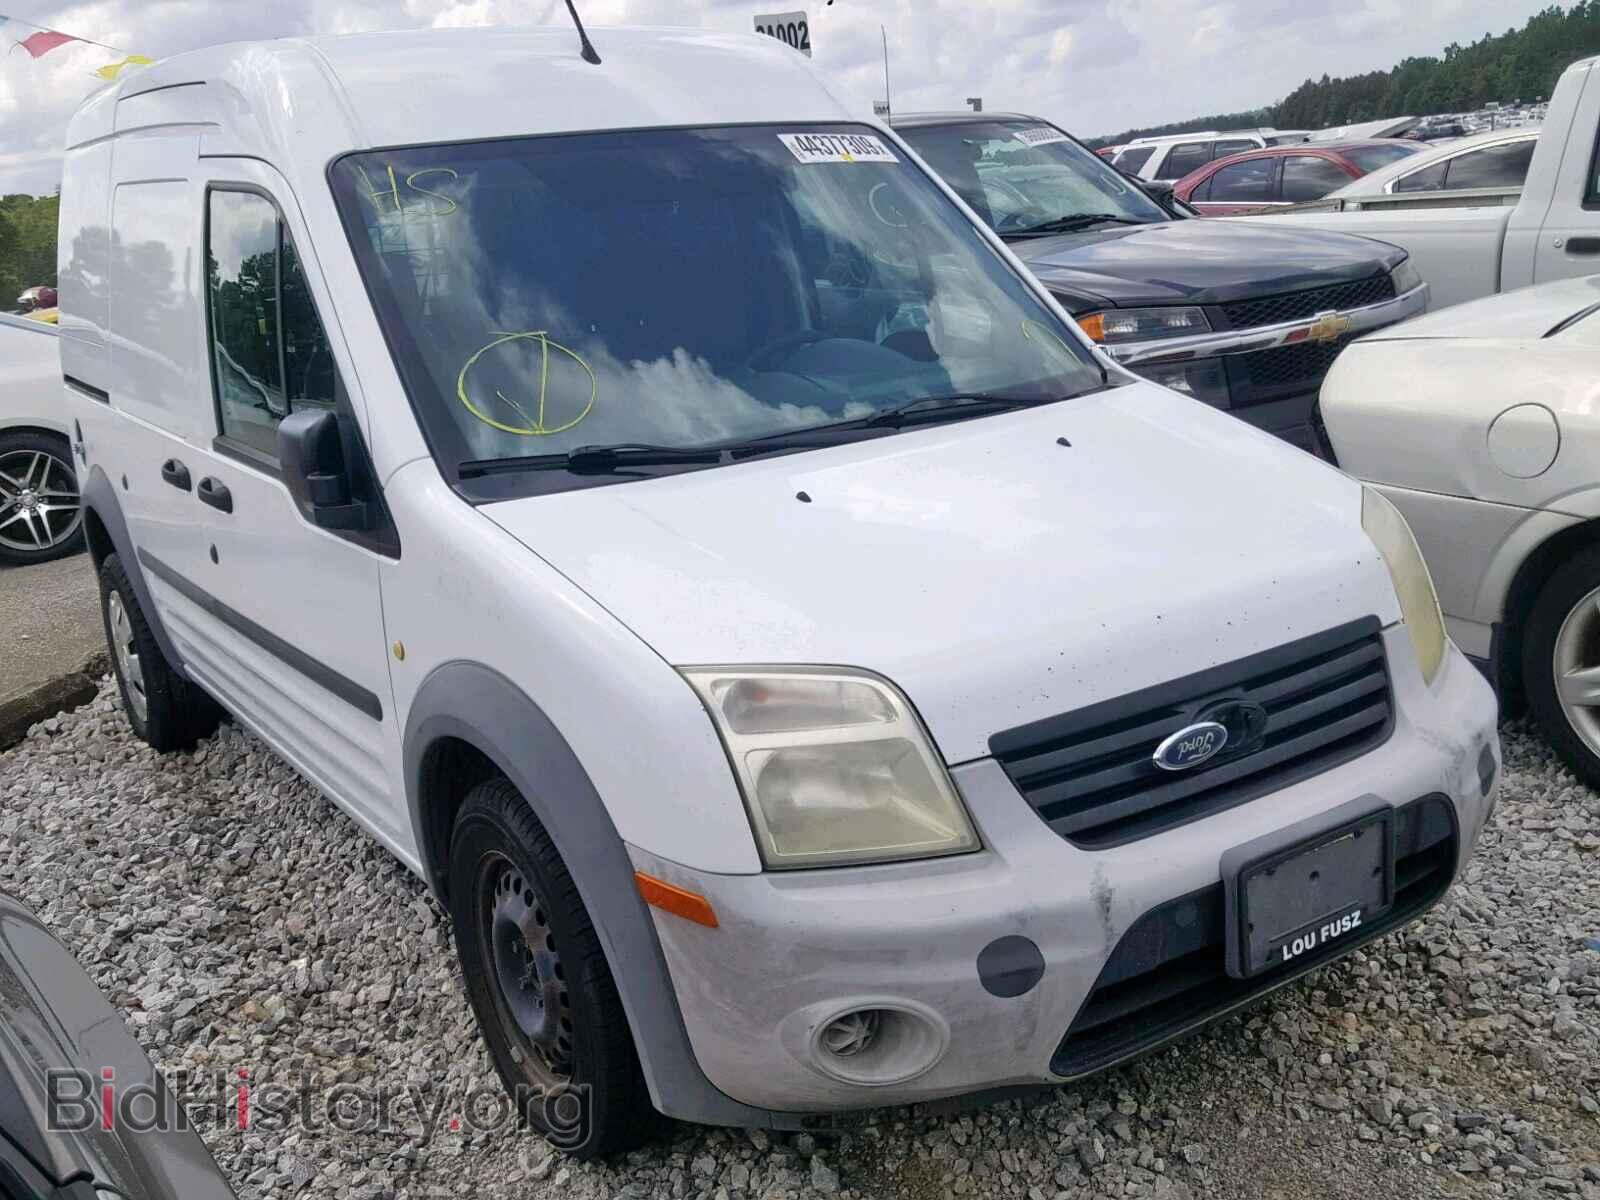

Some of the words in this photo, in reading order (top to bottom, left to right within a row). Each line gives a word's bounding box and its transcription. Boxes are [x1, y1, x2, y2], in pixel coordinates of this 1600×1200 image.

[756, 21, 810, 50] 002
[794, 135, 880, 156] 44377309
[359, 165, 457, 216] HS
[1282, 931, 1316, 961] LOU
[1320, 910, 1362, 943] FUSZ
